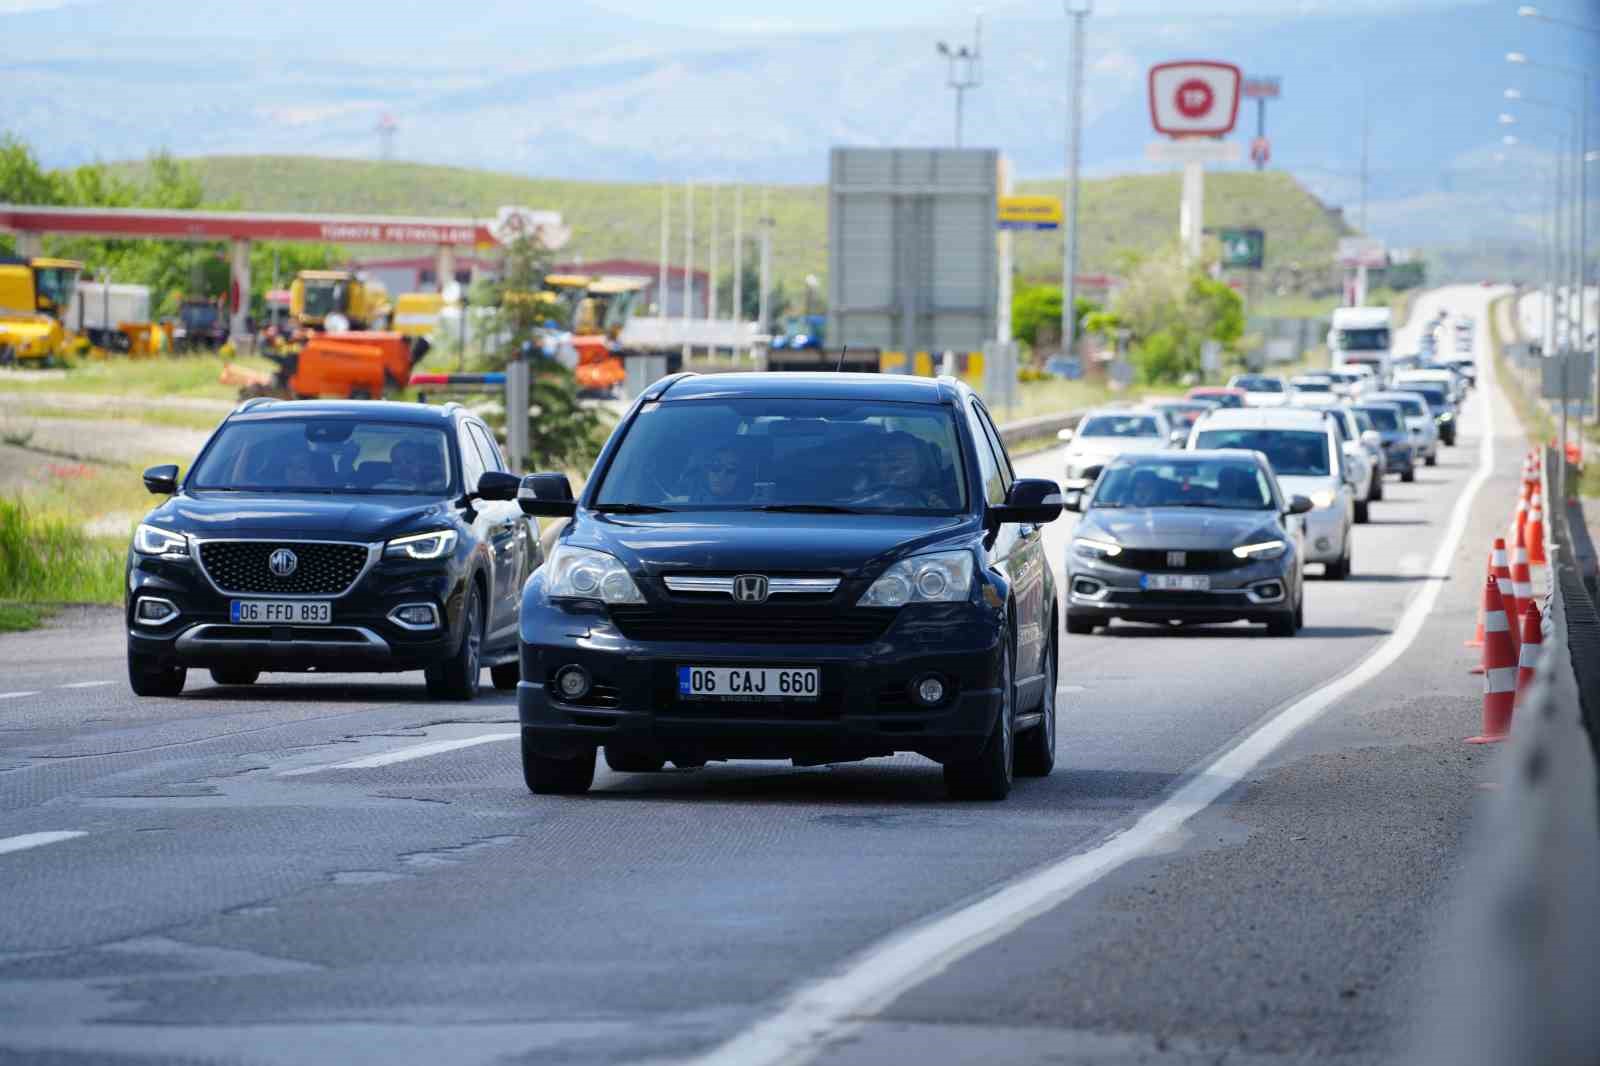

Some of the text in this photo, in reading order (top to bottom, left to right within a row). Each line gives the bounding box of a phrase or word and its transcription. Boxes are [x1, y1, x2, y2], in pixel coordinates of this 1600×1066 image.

[241, 604, 328, 620] 06 FFD 893
[692, 670, 816, 693] 06 CAJ 660
